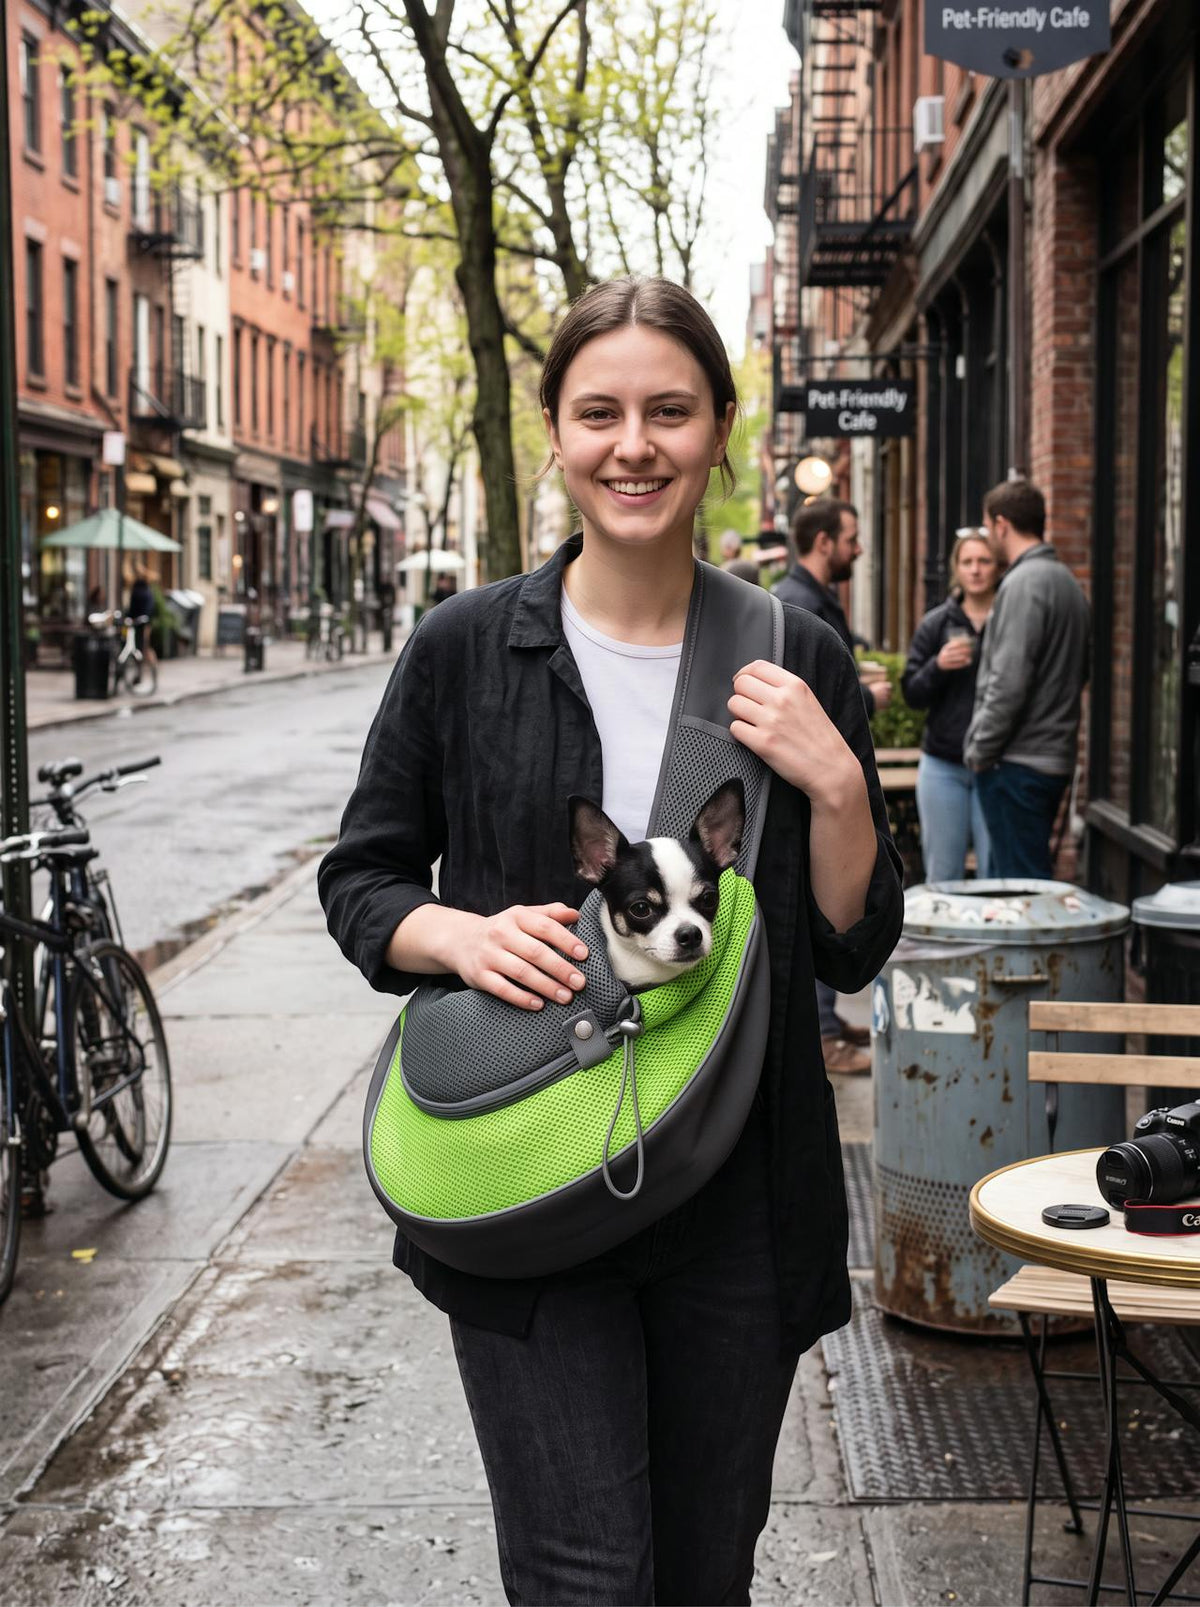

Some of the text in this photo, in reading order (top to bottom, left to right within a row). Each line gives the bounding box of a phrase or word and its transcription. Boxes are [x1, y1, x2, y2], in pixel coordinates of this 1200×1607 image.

[942, 6, 1090, 33] Pet-Friendly Cafe
[808, 387, 908, 413] Pet-Friendly
[838, 410, 877, 431] Cafe
